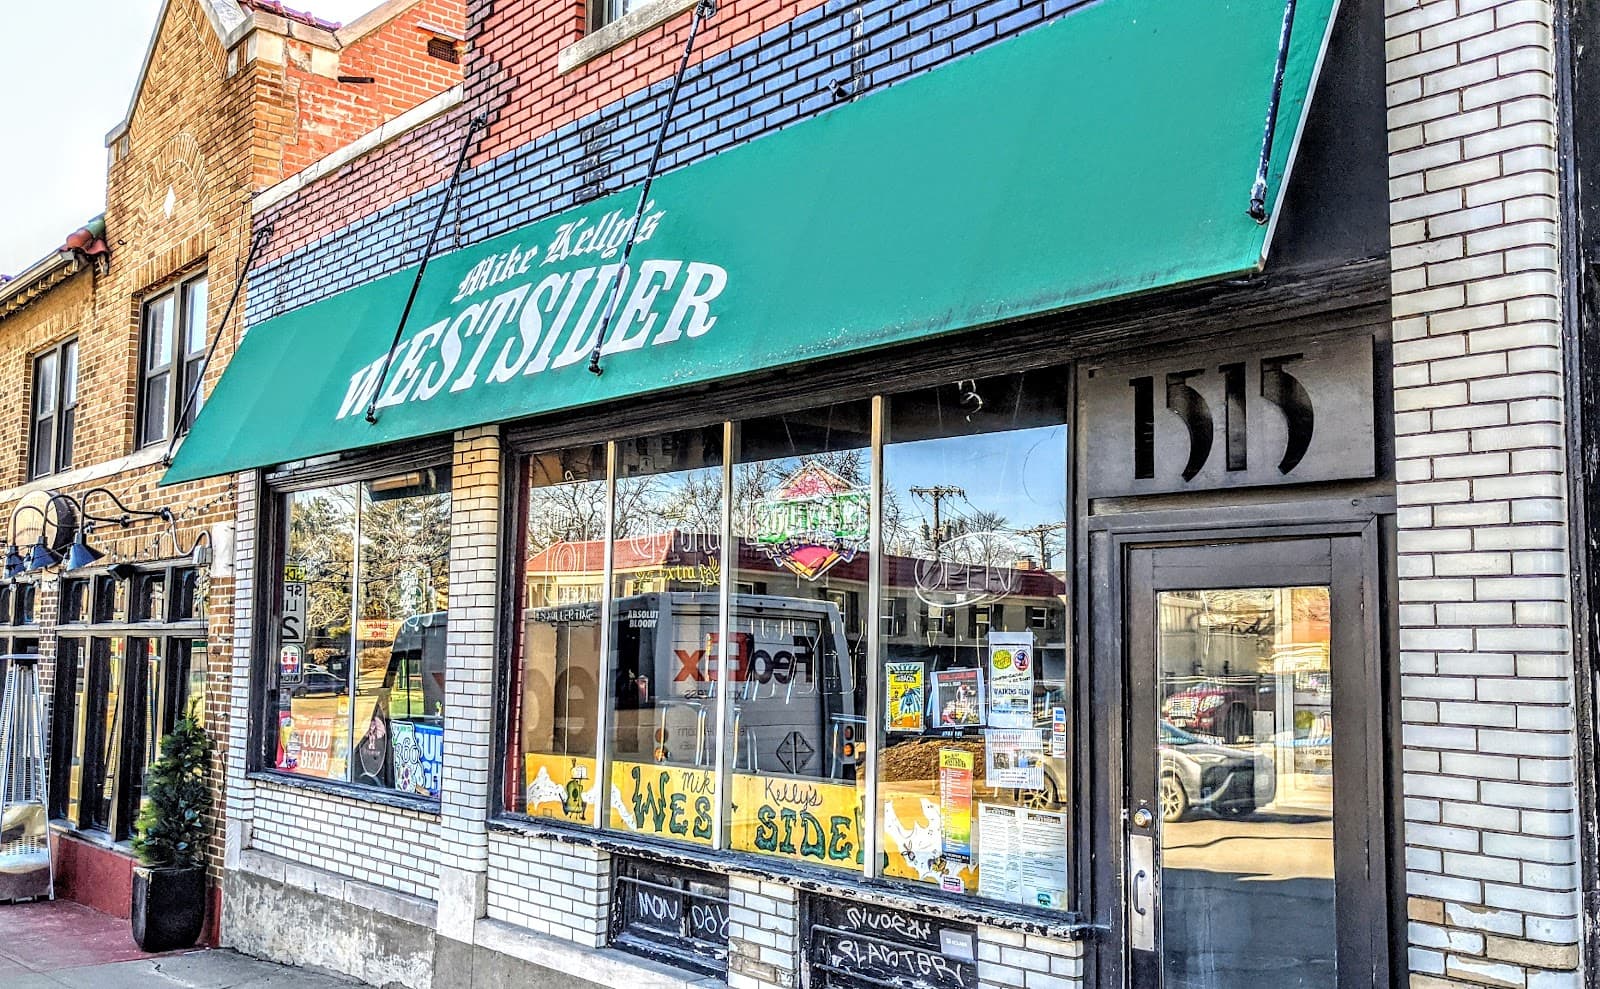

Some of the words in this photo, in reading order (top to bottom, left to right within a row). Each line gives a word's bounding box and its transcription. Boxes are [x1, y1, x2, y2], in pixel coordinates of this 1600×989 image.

[450, 245, 539, 304] Mike
[540, 199, 667, 266] Kelly's
[336, 260, 728, 419] WESTSIDER
[1129, 353, 1314, 482] 1515
[628, 609, 659, 619] ABSOLUT
[301, 750, 329, 771] BEER
[303, 729, 331, 749] COLD
[632, 766, 713, 841] WES
[682, 770, 716, 796] Mik
[765, 779, 824, 810] Kelly's
